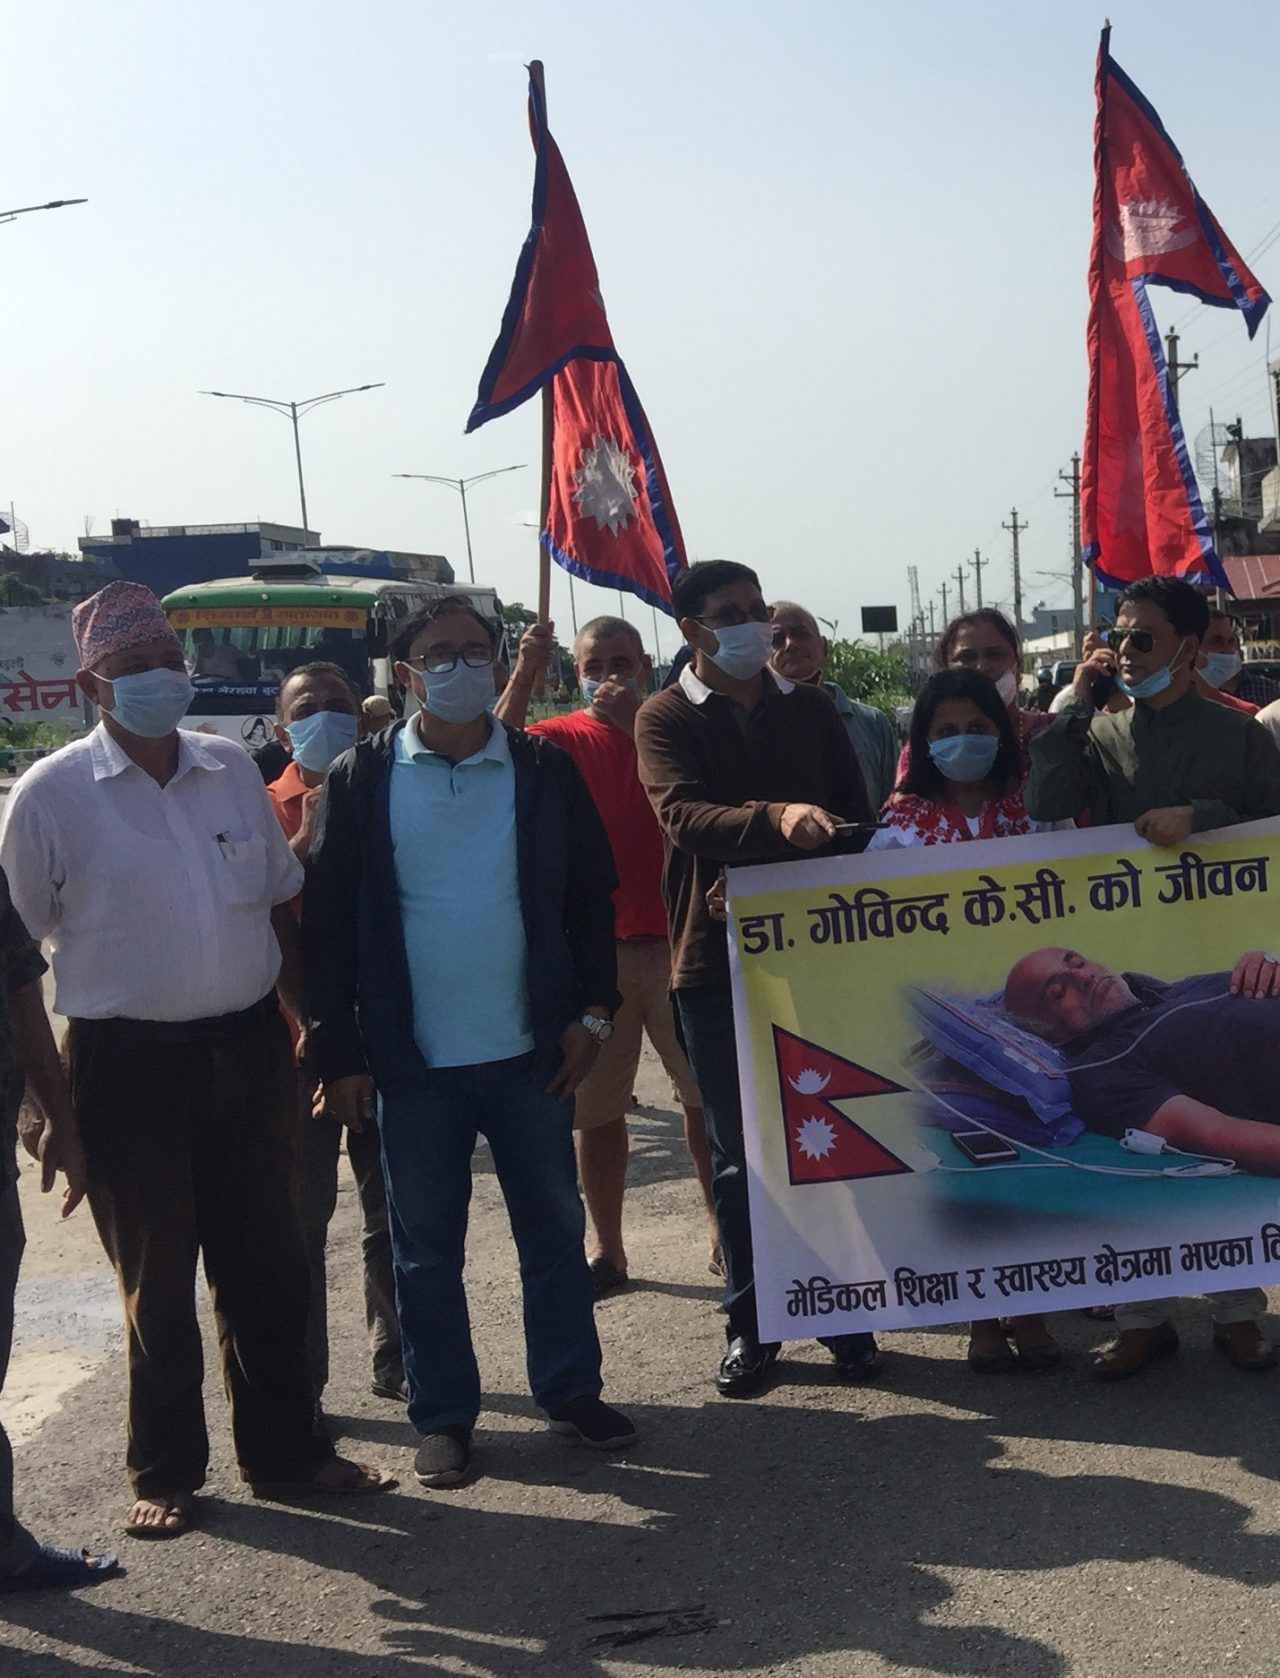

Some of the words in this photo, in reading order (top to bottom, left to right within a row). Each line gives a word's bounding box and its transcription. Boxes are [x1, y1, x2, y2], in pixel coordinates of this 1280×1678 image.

[739, 912, 795, 955] डा.
[807, 887, 949, 945] गोविन्द
[962, 868, 1076, 927] के.सी.
[1088, 859, 1142, 911] को
[1154, 851, 1270, 905] जीवन
[785, 1276, 887, 1317] मेडिकल
[894, 1266, 958, 1307] शिक्षा
[966, 1268, 985, 1299] र
[992, 1256, 1087, 1298] स्वास्थ्य
[1094, 1243, 1172, 1287] क्षेत्रमा
[1180, 1235, 1254, 1272] भएका
